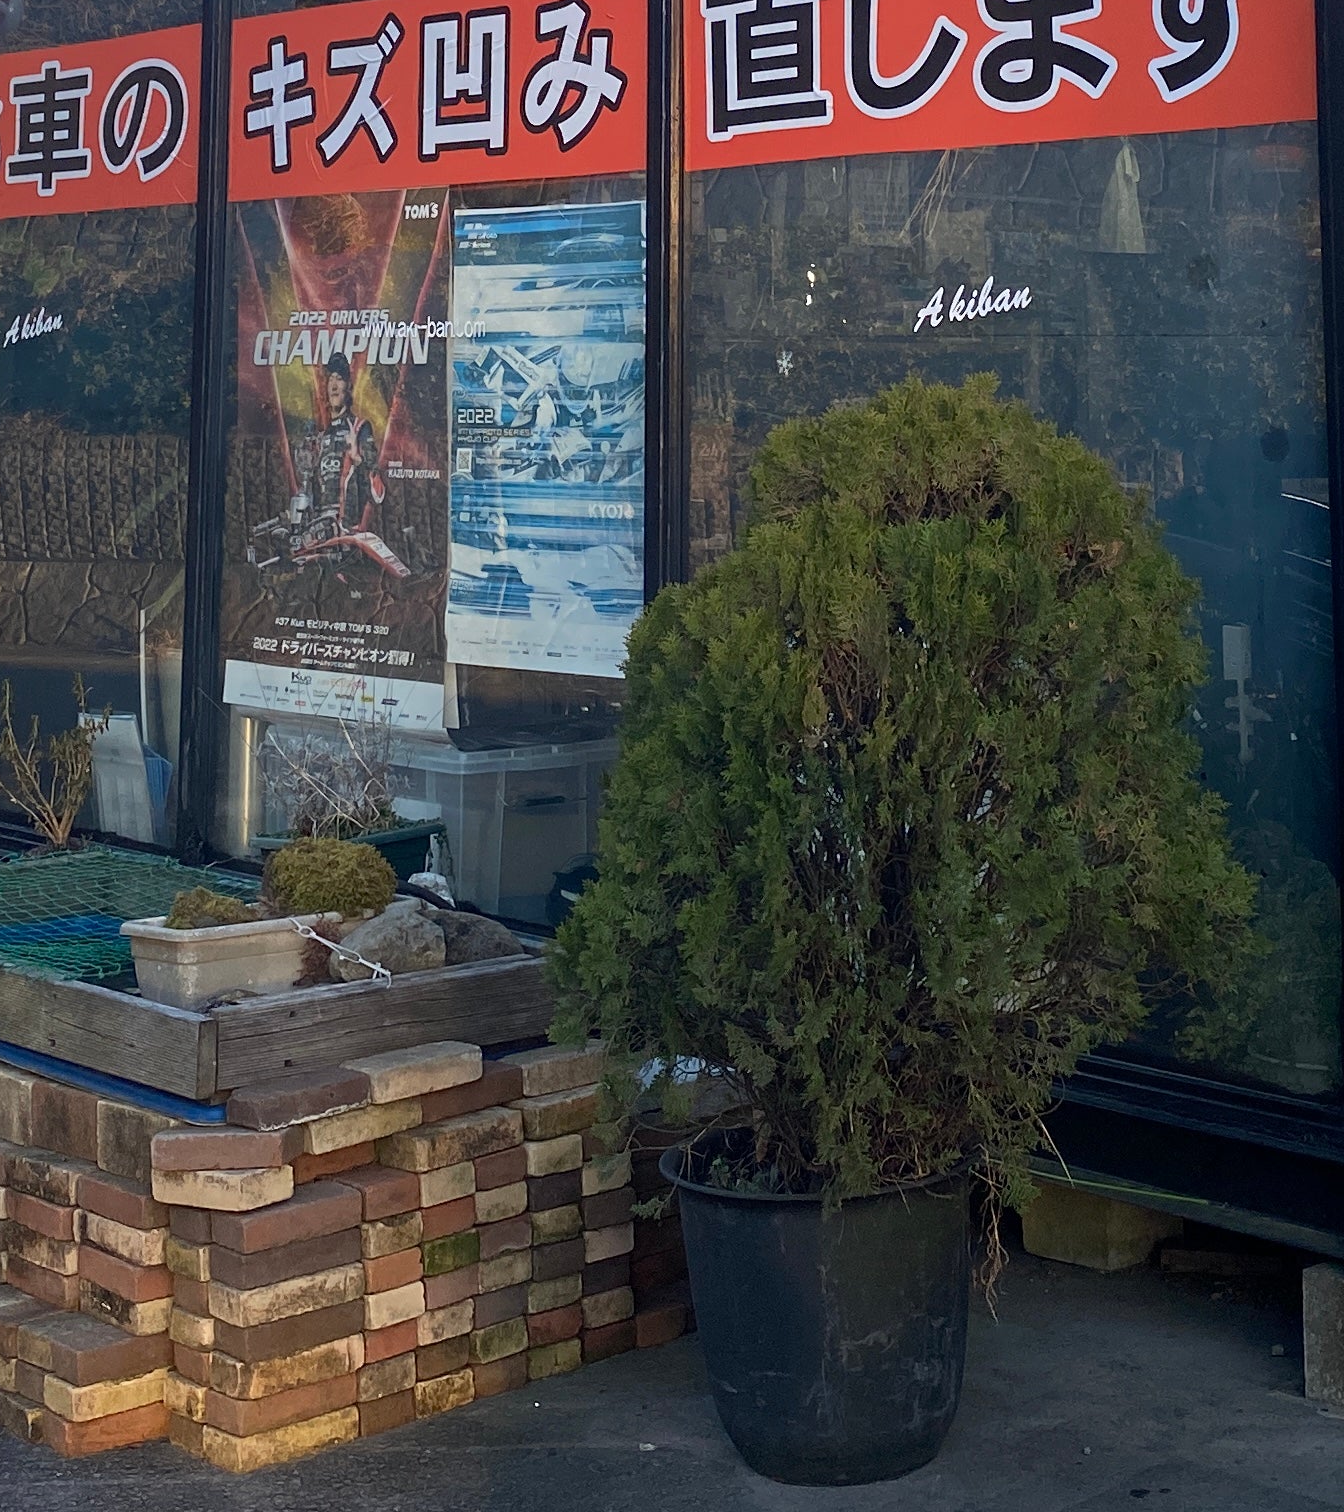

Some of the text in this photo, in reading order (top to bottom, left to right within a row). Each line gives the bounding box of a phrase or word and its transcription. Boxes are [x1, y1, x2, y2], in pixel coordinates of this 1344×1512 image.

[405, 202, 439, 220] TOM'S
[289, 309, 390, 326] 2022 DRIVERS
[254, 329, 431, 366] CHAMPION
[457, 408, 494, 424] 2022
[253, 637, 278, 651] 2022
